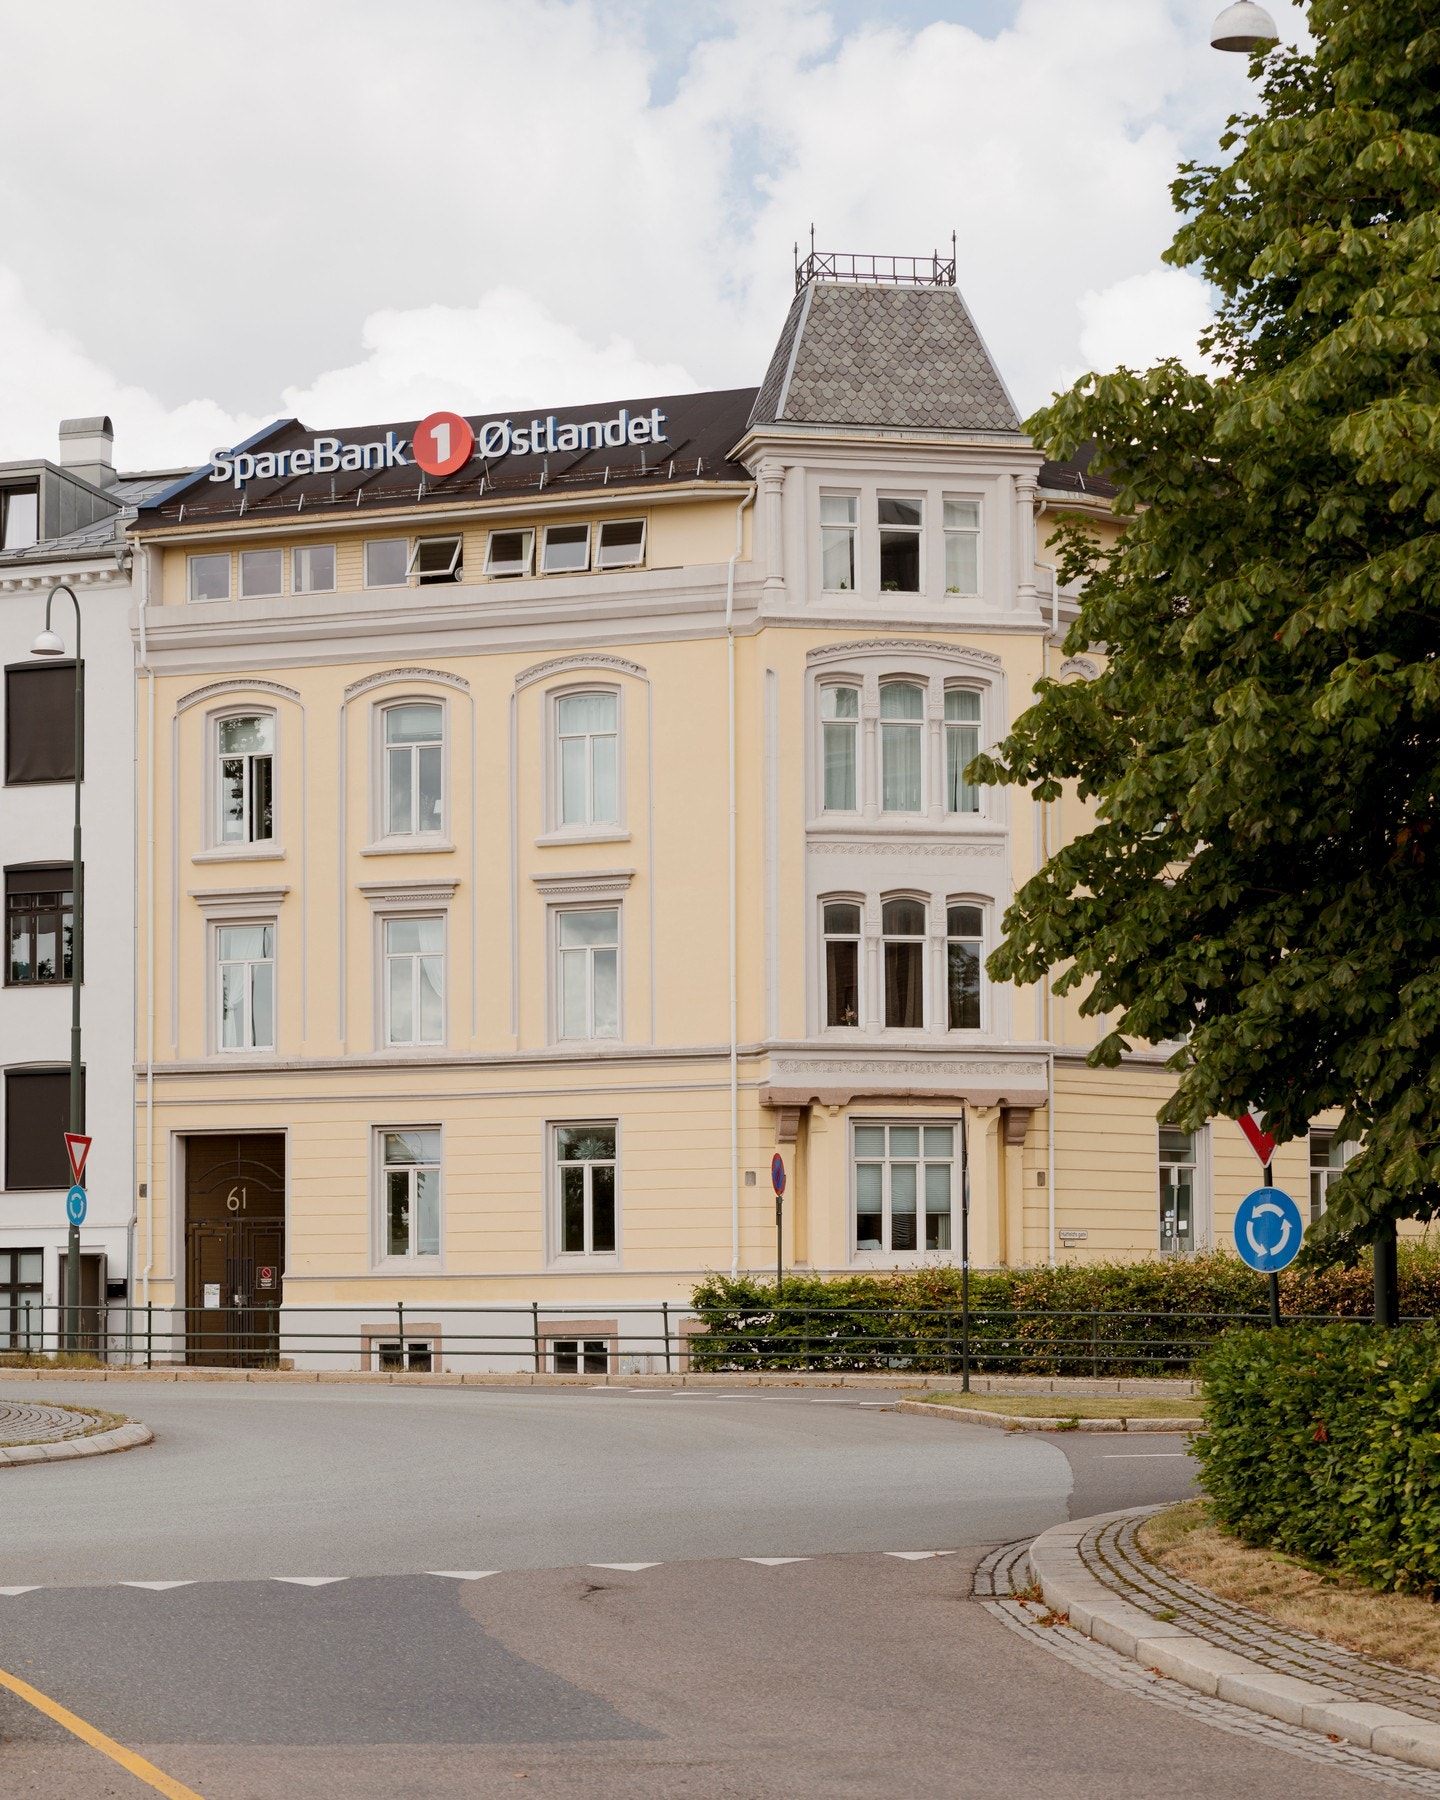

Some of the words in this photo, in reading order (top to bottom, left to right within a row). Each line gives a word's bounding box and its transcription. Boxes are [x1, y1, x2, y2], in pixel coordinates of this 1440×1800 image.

[208, 432, 408, 489] SpareBank
[429, 422, 451, 464] 1
[478, 408, 669, 460] Østlandet
[226, 1186, 247, 1211] 61
